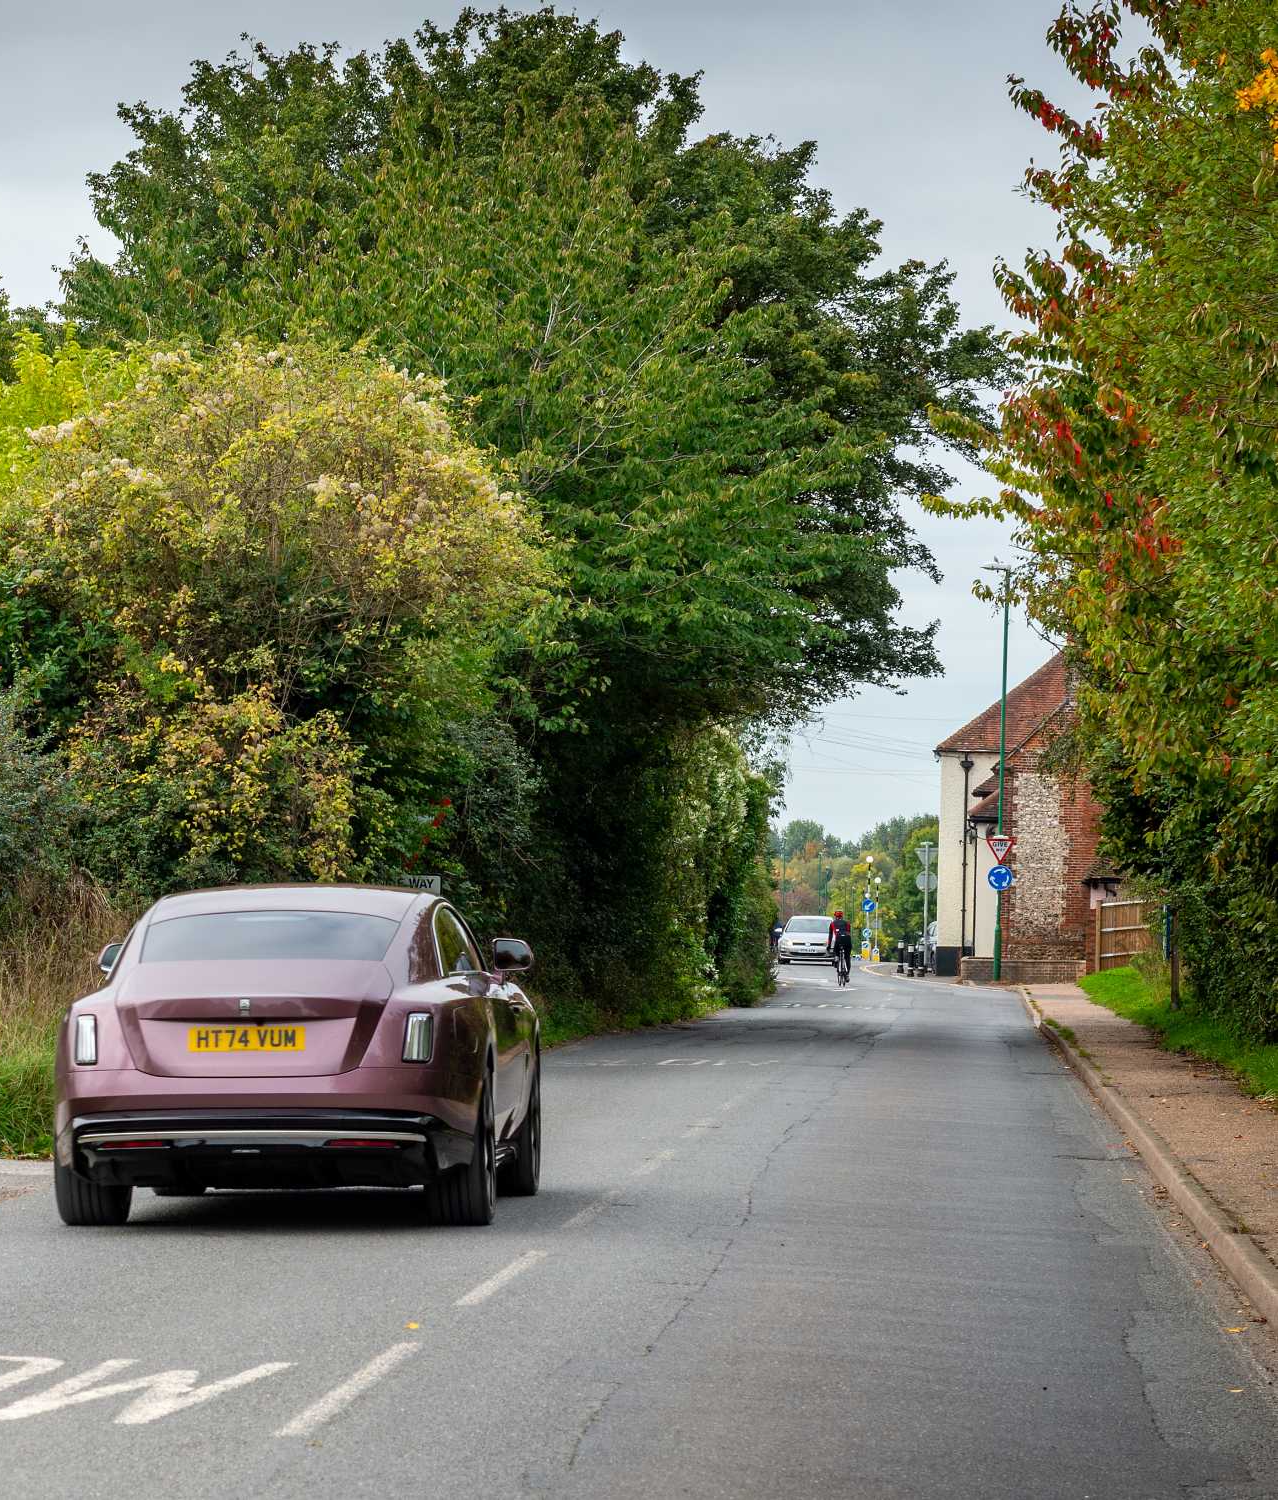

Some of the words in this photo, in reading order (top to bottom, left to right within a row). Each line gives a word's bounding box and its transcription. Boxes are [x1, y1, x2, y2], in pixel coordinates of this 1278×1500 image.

[409, 878, 434, 888] WAY
[197, 1029, 250, 1048] HT74
[257, 1029, 295, 1048] VUM
